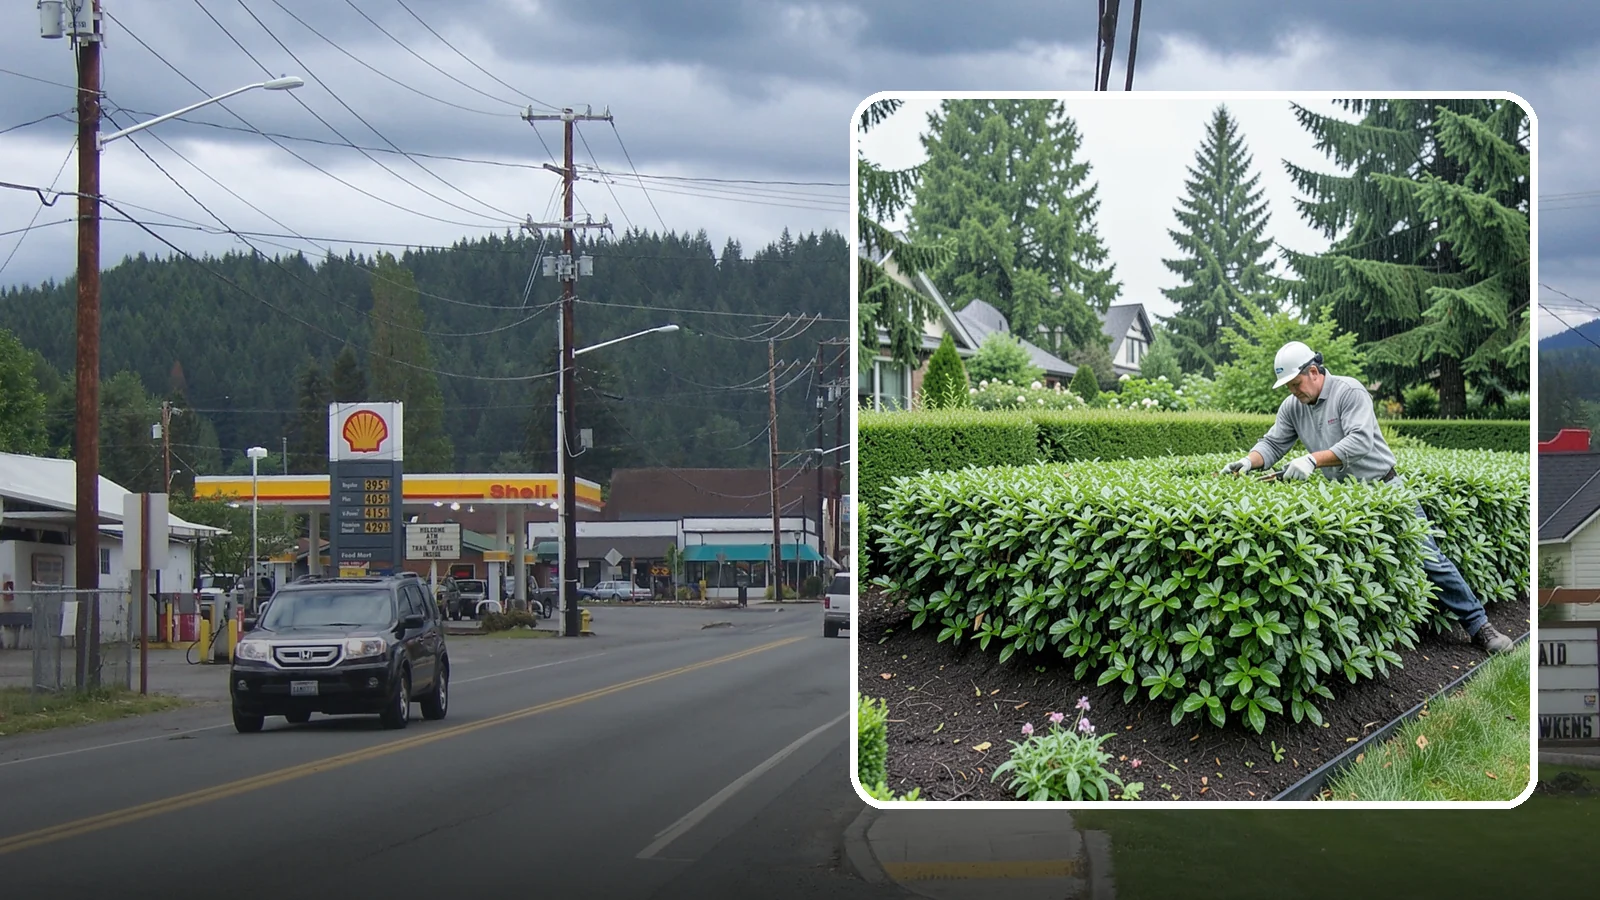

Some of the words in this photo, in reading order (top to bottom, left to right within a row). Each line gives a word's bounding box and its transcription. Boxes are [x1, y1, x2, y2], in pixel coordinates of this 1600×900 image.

[366, 480, 383, 490] 395
[490, 484, 547, 498] Shell
[366, 494, 383, 504] 405
[366, 508, 383, 518] 415
[366, 522, 383, 532] 429
